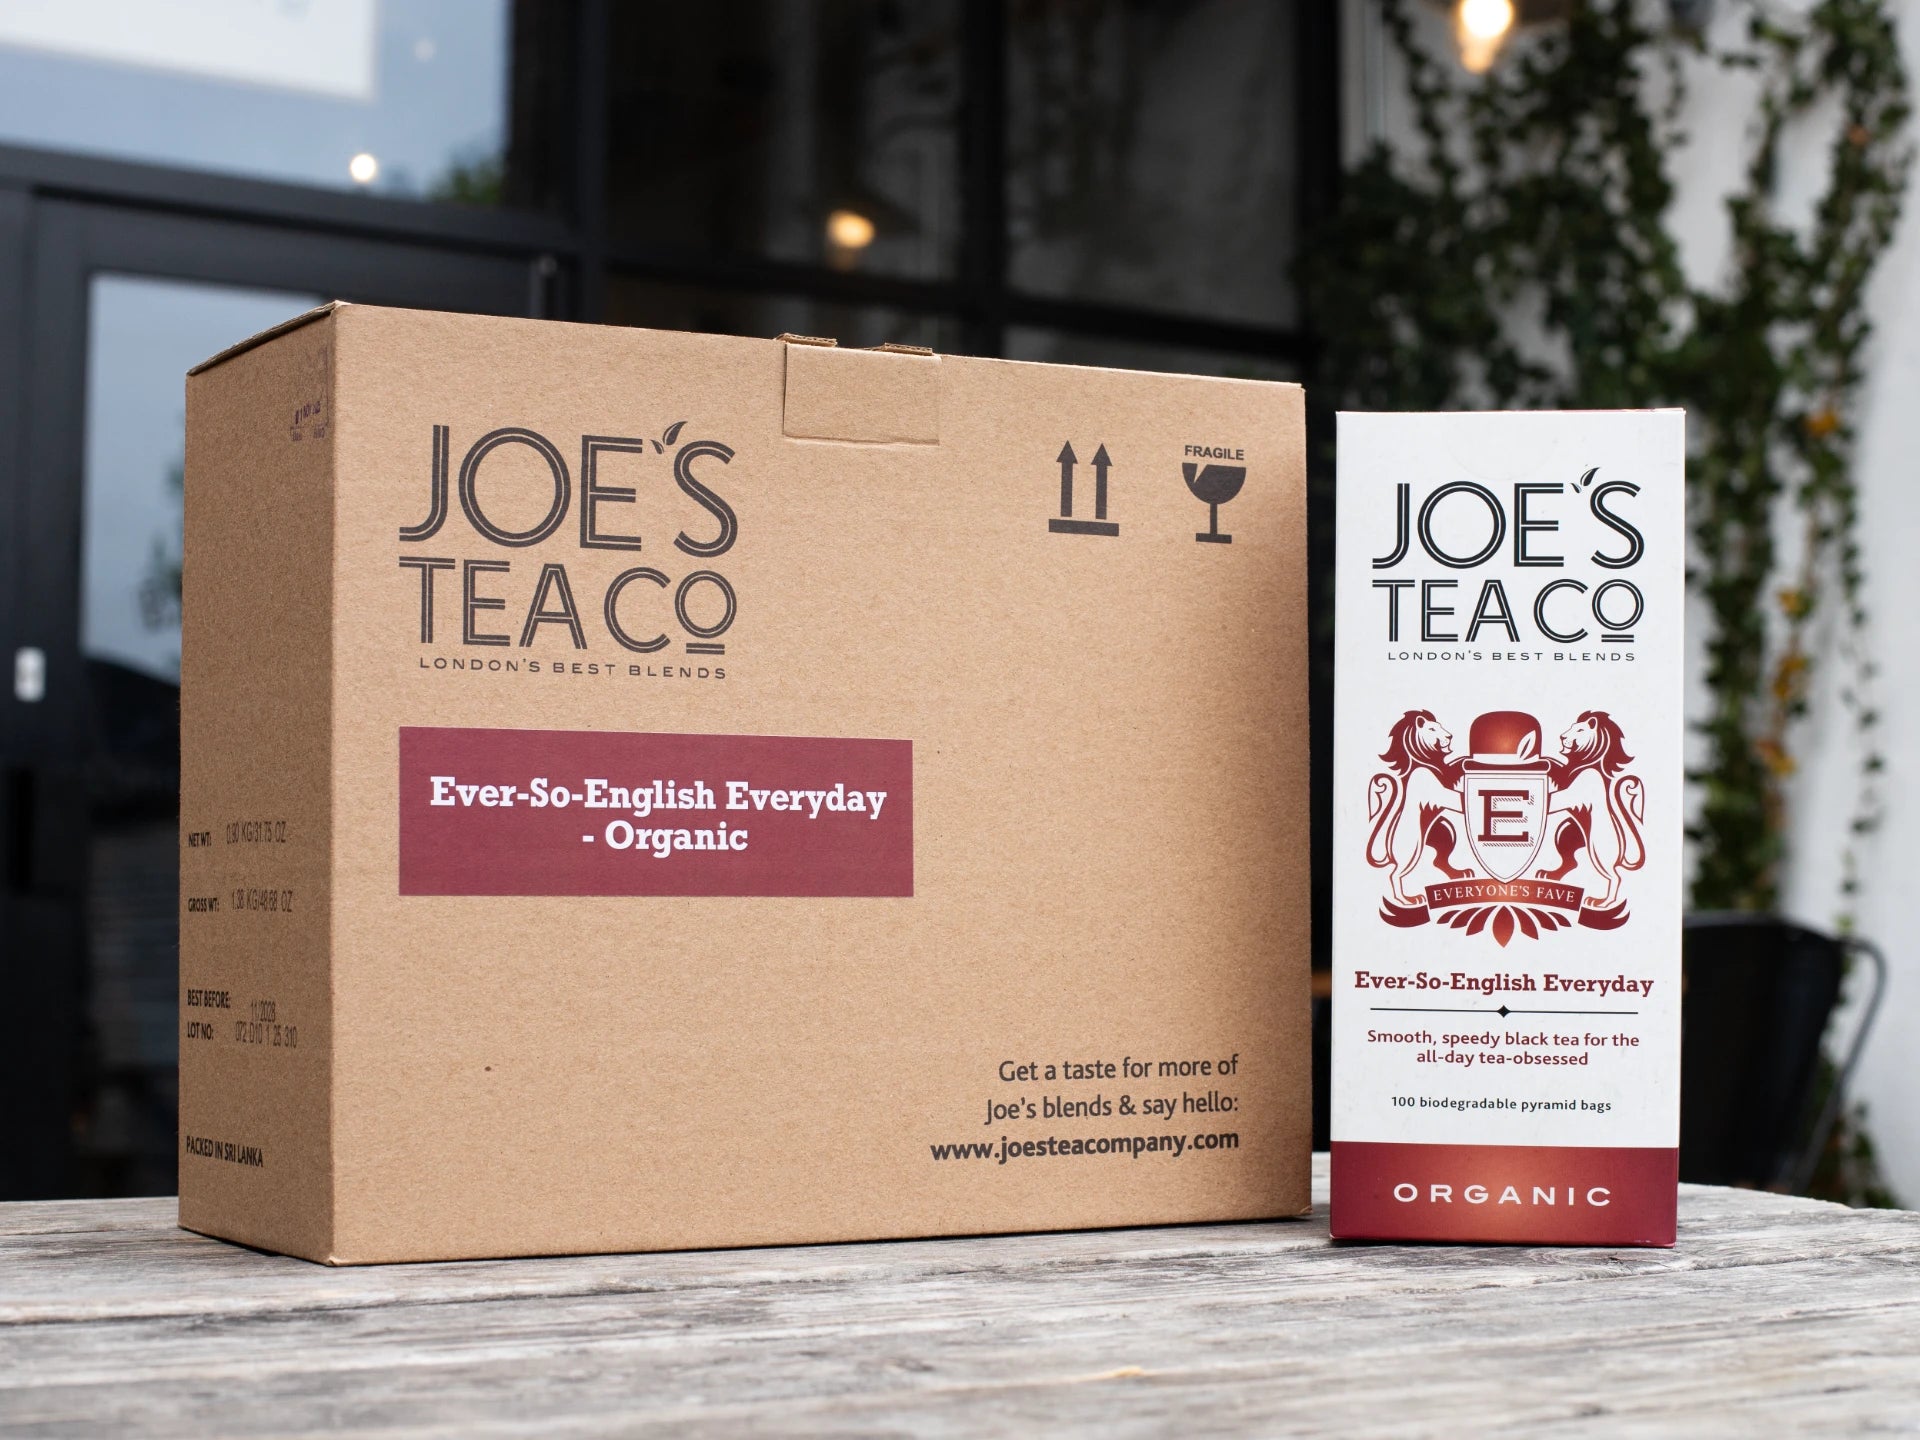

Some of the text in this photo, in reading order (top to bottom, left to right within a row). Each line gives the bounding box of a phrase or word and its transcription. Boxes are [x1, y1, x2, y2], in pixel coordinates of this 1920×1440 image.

[1184, 444, 1245, 461] FRAGILE
[399, 421, 738, 558] JOE'S
[1372, 467, 1645, 569] JOE'S
[420, 657, 727, 680] LONDON'S BEST BLENDS
[1388, 650, 1636, 662] LONDON'S BEST BLENDS
[430, 776, 888, 820] Ever-So-English Everyday
[1477, 789, 1535, 847] E
[188, 832, 200, 848] NET
[275, 821, 287, 843] OZ
[605, 820, 749, 858] Organic
[188, 898, 207, 912] GROSS
[280, 890, 293, 912] OZ
[1433, 885, 1576, 904] EVERYONE'S FAVE
[1354, 971, 1654, 997] Ever-So-English Everyday
[187, 989, 203, 1006] BEST
[203, 991, 231, 1009] BEFORE:
[187, 1022, 199, 1039] LOT
[1367, 1030, 1640, 1049] Smooth, speedy black tea for the
[999, 1054, 1239, 1082] Get a taste for more of
[1416, 1050, 1588, 1067] all-day tea-obsessed
[984, 1091, 1239, 1125] Joe's blends & say hello:
[1391, 1096, 1612, 1113] 100 biodegradable pyramid bags
[186, 1135, 263, 1168] PACKED IN SRI LANKA
[930, 1133, 1239, 1165] www.joesteacompany.com
[1393, 1182, 1612, 1207] ORGANIC
